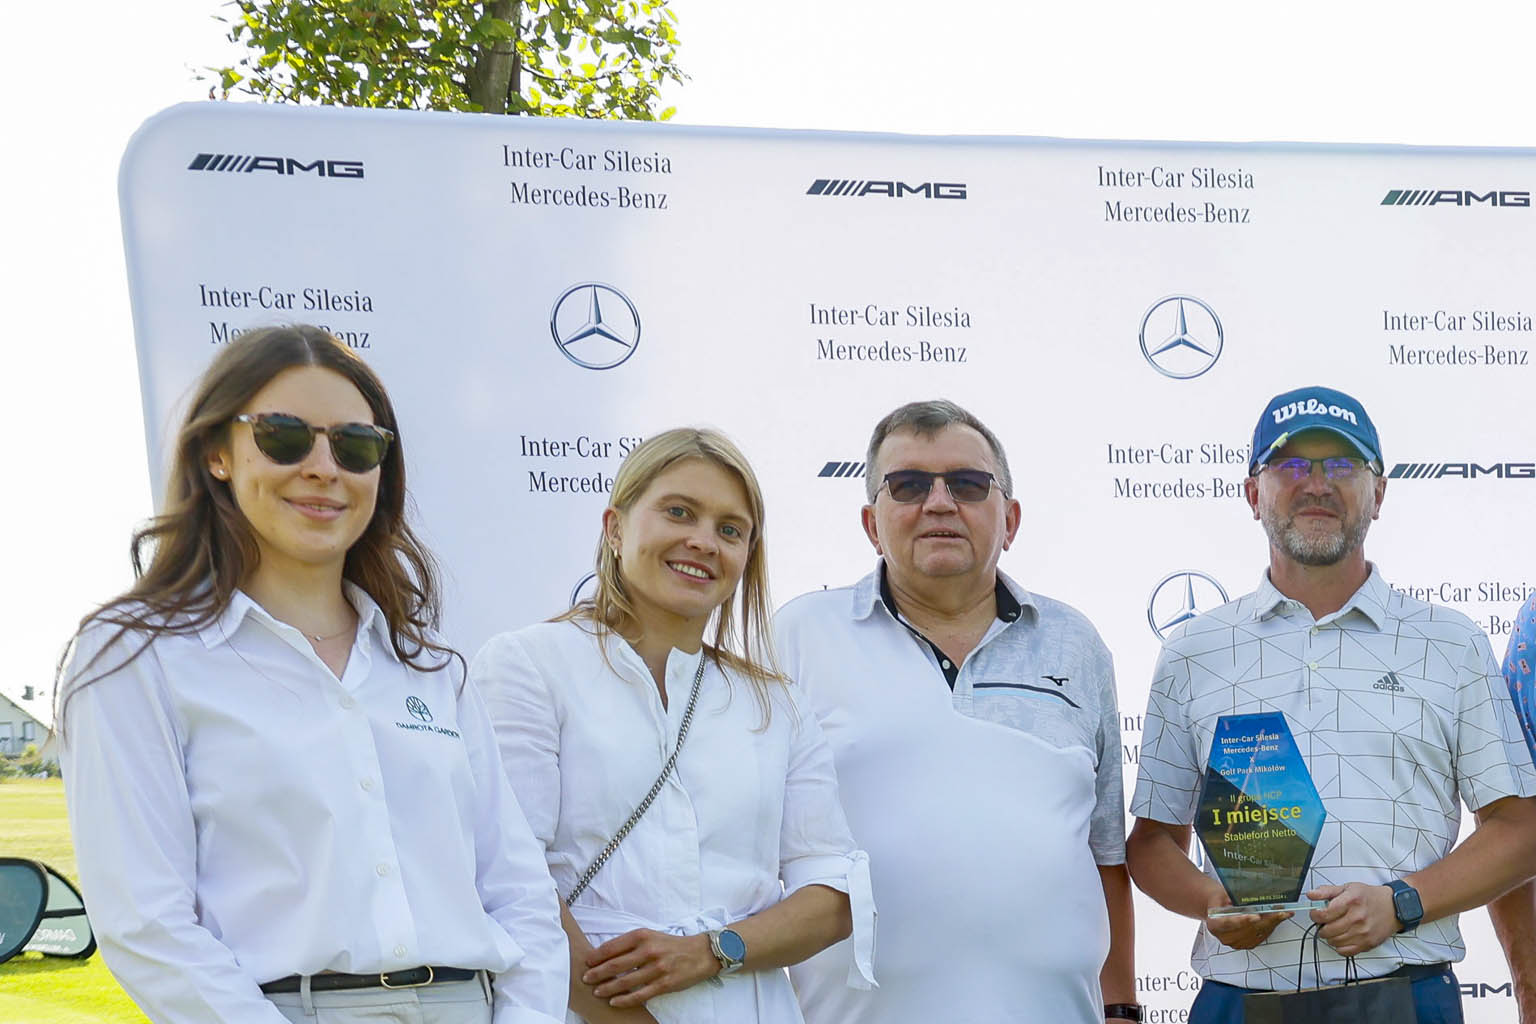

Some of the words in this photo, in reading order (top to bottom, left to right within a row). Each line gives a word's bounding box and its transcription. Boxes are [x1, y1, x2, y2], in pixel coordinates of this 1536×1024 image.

[246, 156, 364, 178] AMG
[503, 145, 597, 171] Inter-Car
[604, 149, 672, 174] Silesia
[1097, 166, 1184, 188] Inter-Car
[1191, 167, 1254, 189] Silesia
[510, 182, 668, 209] Mercedes-Benz
[858, 181, 967, 199] AMG
[1429, 190, 1530, 207] AMG
[1104, 200, 1250, 223] Mercedes-Benz
[199, 284, 296, 310] Inter-Car
[303, 288, 374, 313] Silesia
[810, 303, 899, 327] Inter-Car
[906, 305, 971, 329] Silesia
[1383, 310, 1466, 332] Inter-Car
[1472, 311, 1533, 332] Silesia
[816, 339, 968, 363] Mercedes-Benz
[1389, 344, 1529, 366] Mercedes-Benz
[1272, 398, 1358, 425] Wilson
[520, 435, 612, 458] Inter-Car
[1107, 443, 1194, 464] Inter-Car
[1200, 442, 1251, 465] Silesi
[1434, 463, 1536, 479] AMG
[528, 471, 614, 494] Mercede
[1113, 477, 1246, 499] Mercedes-Ben
[1372, 683, 1405, 692] adidas
[1221, 735, 1254, 745] Inter-Car
[1223, 744, 1279, 755] Mercedes-Benz
[1220, 768, 1236, 776] Golf
[1236, 766, 1253, 775] Park
[1212, 808, 1222, 825] I
[1226, 804, 1303, 825] miejsce
[1224, 830, 1269, 842] Stableford
[1271, 828, 1297, 838] Netto
[1136, 970, 1200, 992] nter-Ca
[1460, 983, 1512, 998] AM
